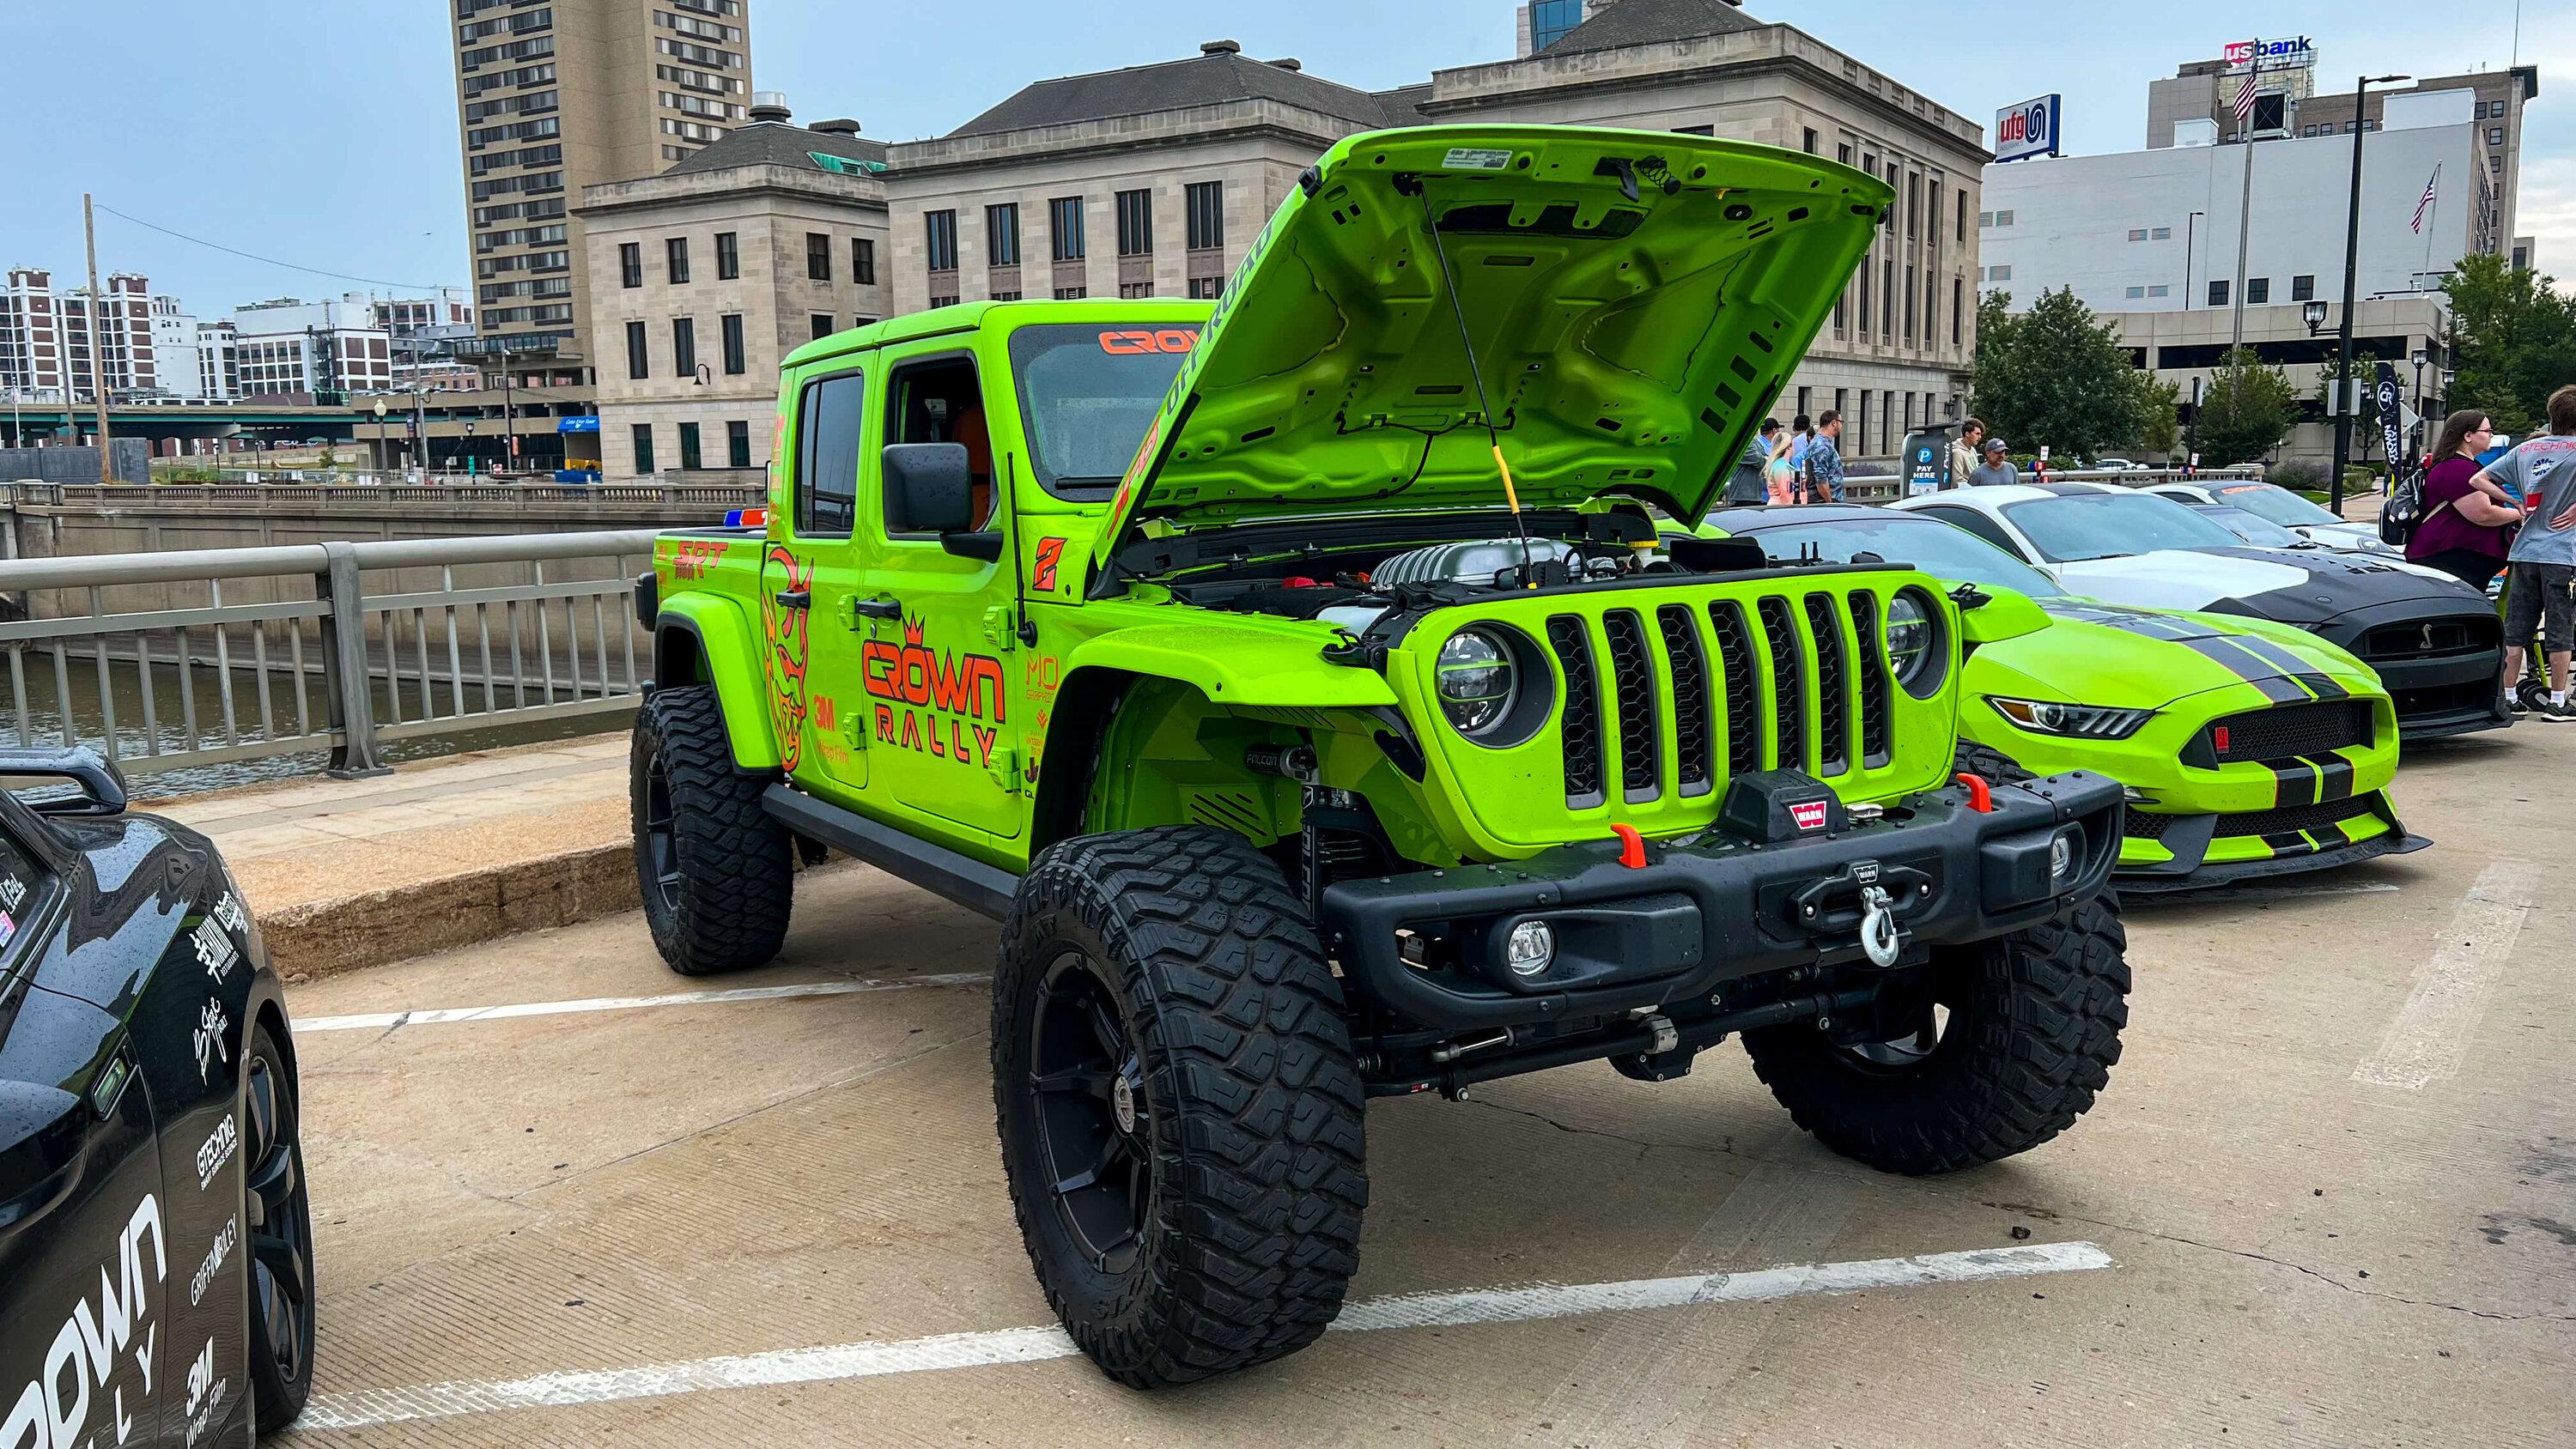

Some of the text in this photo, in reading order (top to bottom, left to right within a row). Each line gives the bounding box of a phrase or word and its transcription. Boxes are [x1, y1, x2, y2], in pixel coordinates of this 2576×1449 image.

[2000, 111, 2025, 142] ufg
[1206, 221, 1273, 344] ROAD
[1099, 330, 1200, 355] CRO
[2520, 440, 2576, 453] GTECHNI
[672, 540, 729, 579] SRT
[1032, 536, 1069, 592] 2
[861, 639, 1006, 725] CROWN
[812, 694, 836, 733] 3M
[874, 701, 998, 770] RALLY
[1797, 809, 1822, 822] WARN
[1859, 870, 1875, 878] WARN
[197, 1113, 236, 1178] GTECHNIQ
[88, 1319, 156, 1449] LY
[185, 1336, 213, 1417] 3M
[185, 1376, 226, 1449] Wrap Film
